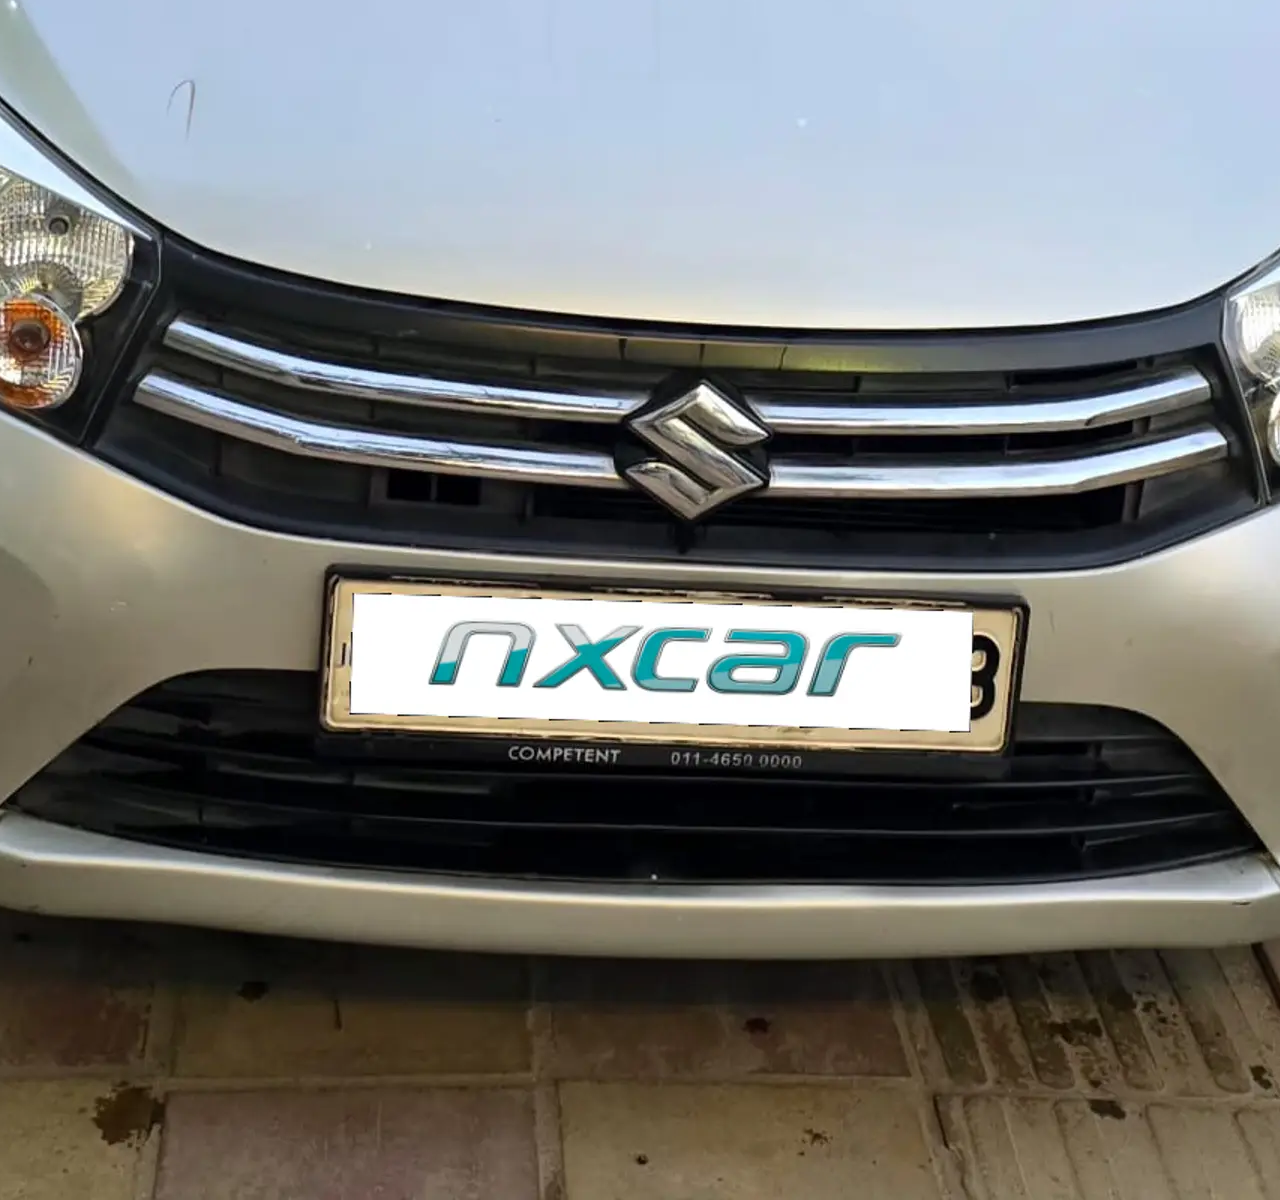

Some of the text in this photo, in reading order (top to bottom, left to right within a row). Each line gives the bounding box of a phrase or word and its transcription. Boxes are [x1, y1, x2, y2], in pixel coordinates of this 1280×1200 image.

[507, 745, 802, 769] COMPETENT 011-4650 0000
